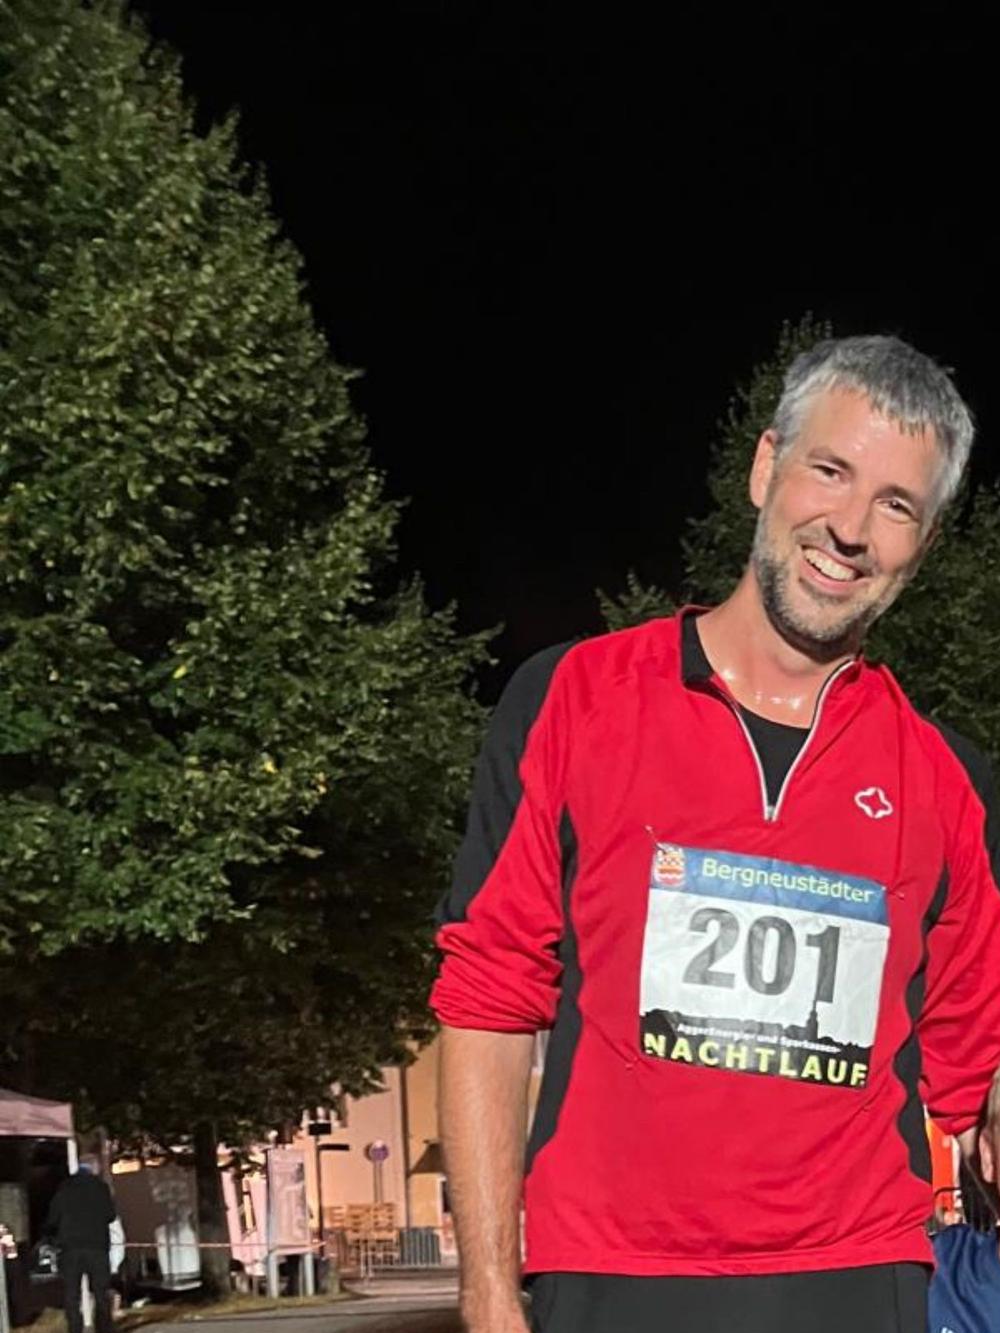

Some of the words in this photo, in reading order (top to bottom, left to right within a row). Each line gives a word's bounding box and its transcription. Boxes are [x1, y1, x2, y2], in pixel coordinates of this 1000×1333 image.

[702, 858, 875, 903] Bergneustädter
[682, 907, 841, 1004] 201
[643, 1033, 868, 1086] NACHTLAUF
